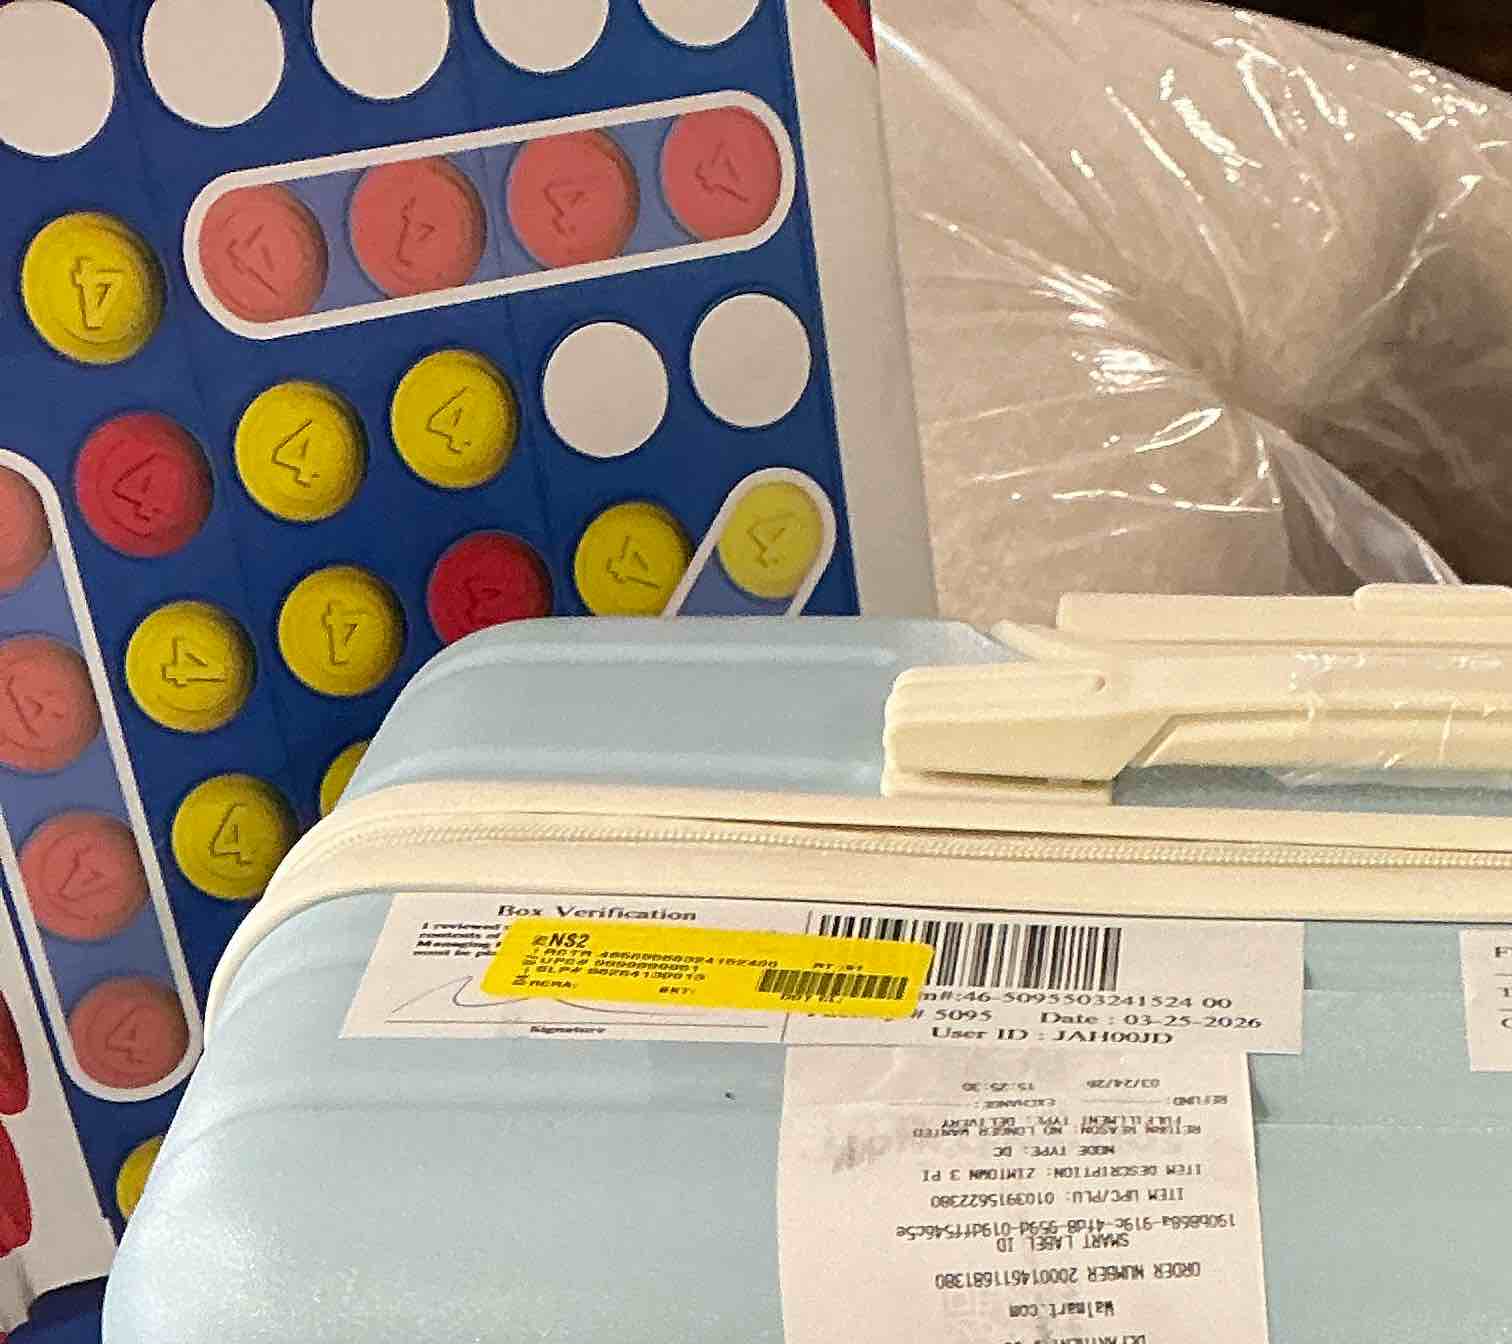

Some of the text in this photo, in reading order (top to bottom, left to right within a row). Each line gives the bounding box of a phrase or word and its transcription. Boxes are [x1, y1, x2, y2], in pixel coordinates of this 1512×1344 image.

[70, 255, 124, 330] 4
[426, 384, 476, 455] 4
[272, 418, 324, 488] 4
[111, 453, 163, 524] 4
[161, 636, 227, 687] 4
[208, 802, 252, 865] 4
[498, 905, 698, 921] Box Verification
[935, 1009, 993, 1022] 5095
[1041, 1011, 1098, 1025] Date
[1124, 1014, 1262, 1029] 03-25-2026
[932, 1027, 988, 1039] User
[998, 1028, 1029, 1041] ID
[941, 1116, 1015, 1128] DELIVERY
[1146, 1126, 1201, 1136] RETURN
[978, 1127, 1034, 1137] LONGER
[992, 1146, 1012, 1158] DC
[1024, 1146, 1066, 1157] TYPE:
[922, 1164, 1201, 1182] ITEM DESCRIPTION: ZIMTOWN 3 PI
[930, 1188, 1184, 1208] ITEM UPC/PLU: 0103915622380
[996, 1233, 1129, 1253] SMART LABEL ID
[936, 1262, 1200, 1289] ORDER NUMBER 200014611681380
[1009, 1301, 1114, 1318] Walmart.com
